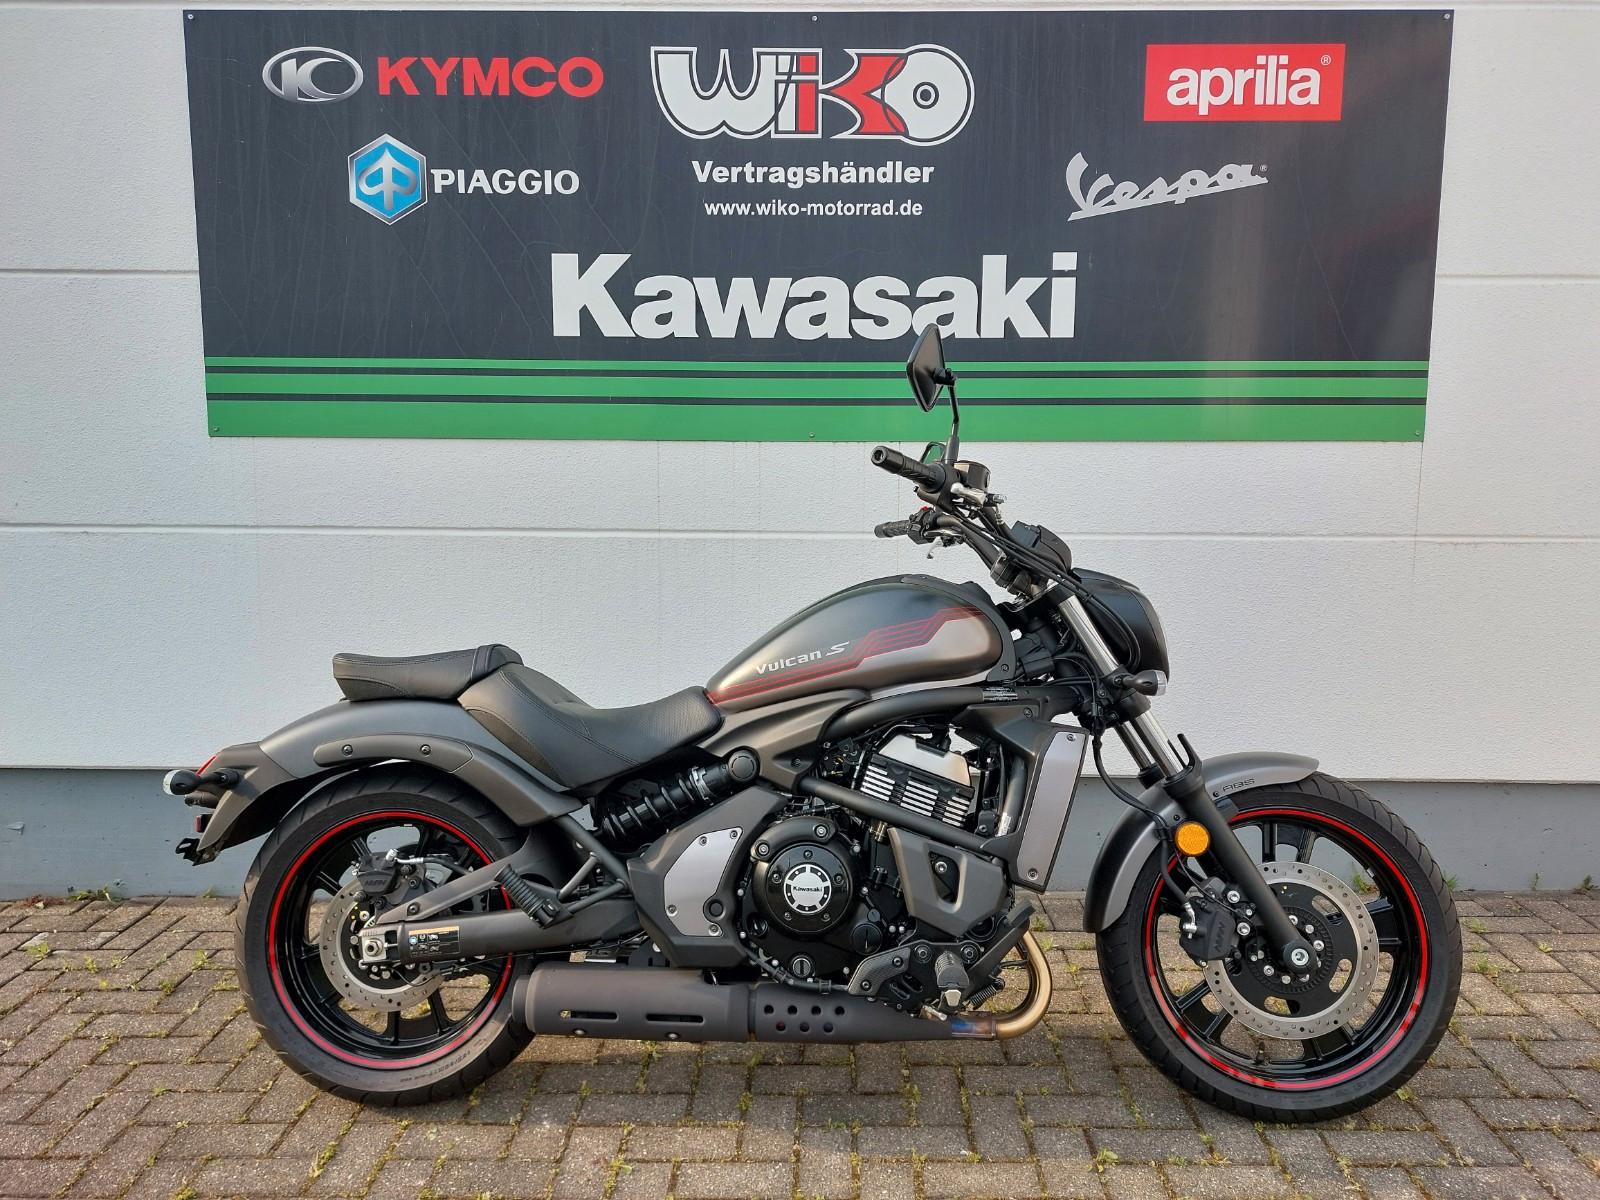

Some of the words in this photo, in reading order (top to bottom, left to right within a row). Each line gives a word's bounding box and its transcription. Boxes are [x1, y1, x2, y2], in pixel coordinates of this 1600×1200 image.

[377, 56, 604, 98] KYMCO
[1166, 55, 1321, 116] aprilia
[431, 168, 580, 195] PIAGGIO
[692, 160, 936, 189] Vertragshändler
[1065, 151, 1269, 222] Vespa
[704, 199, 924, 217] www.wiko-motorrad.de
[551, 251, 1079, 341] Kawasaki
[756, 650, 822, 675] Vulcan
[825, 641, 851, 657] S
[1222, 778, 1256, 792] ABS
